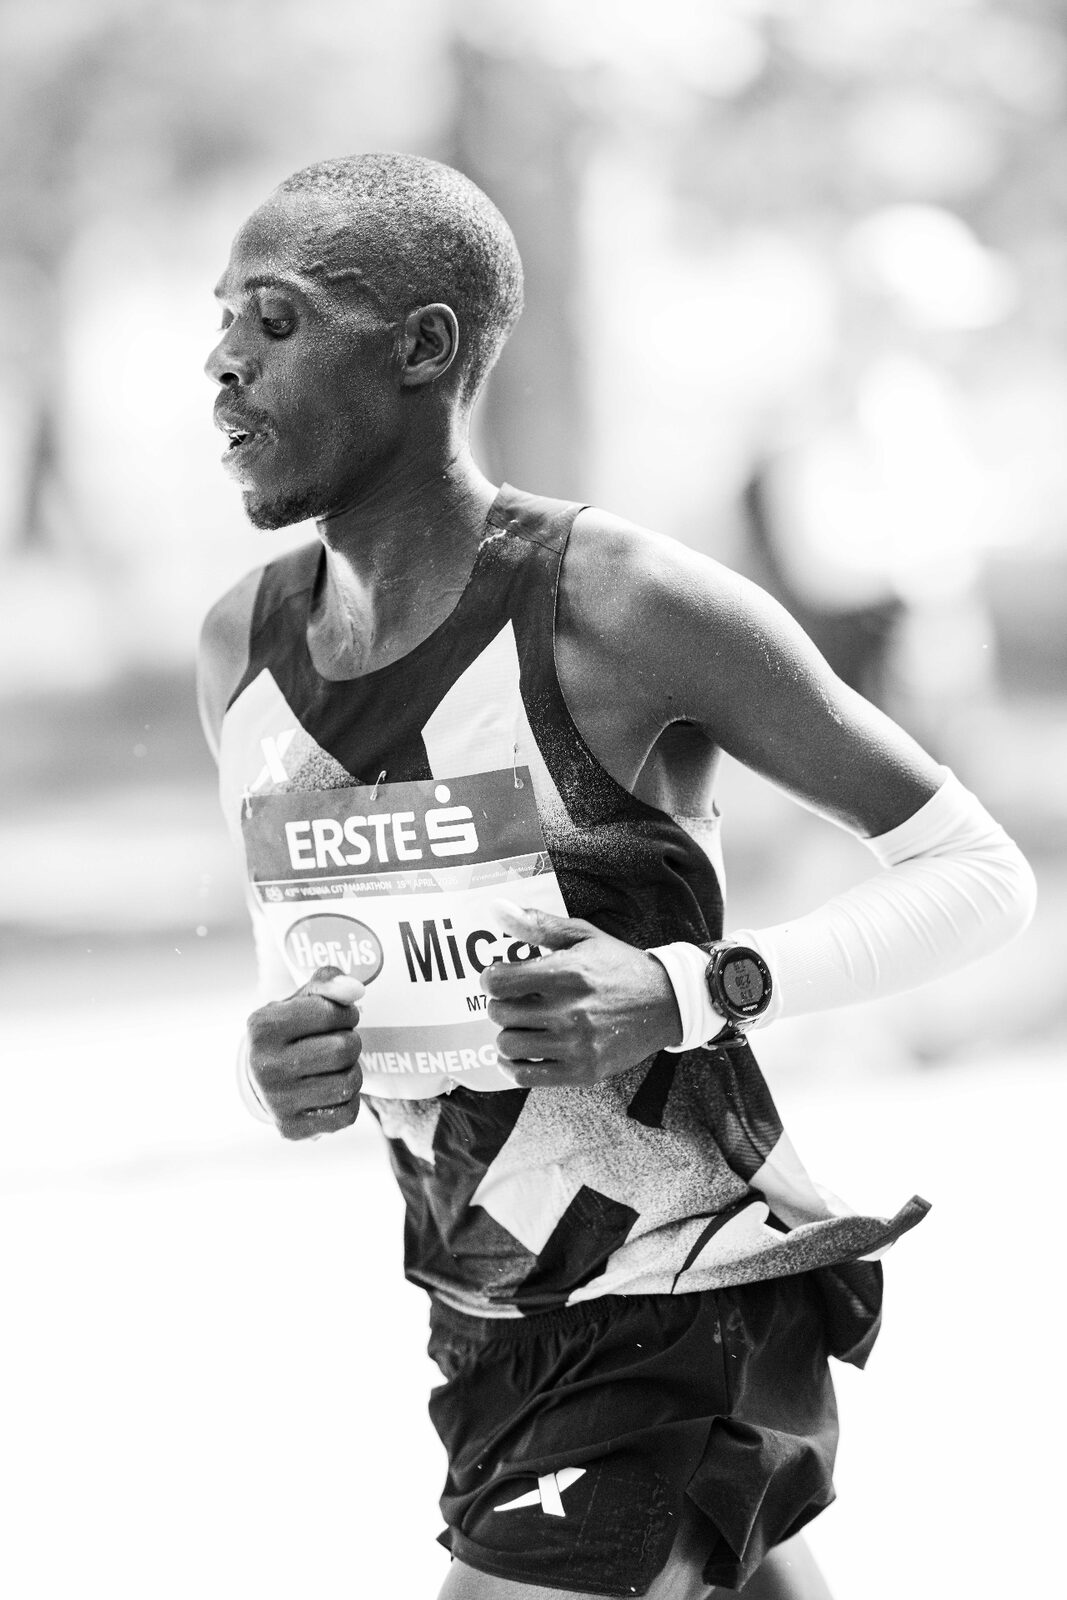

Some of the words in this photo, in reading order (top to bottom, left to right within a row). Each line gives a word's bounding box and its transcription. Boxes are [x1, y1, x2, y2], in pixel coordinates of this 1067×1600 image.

[285, 811, 424, 871] ERSTE
[300, 885, 331, 896] VIENNA
[330, 882, 348, 894] CITY
[349, 880, 391, 892] MARATHON
[414, 878, 436, 889] APRIL
[289, 931, 377, 975] Hervis
[360, 1049, 412, 1074] WIEN
